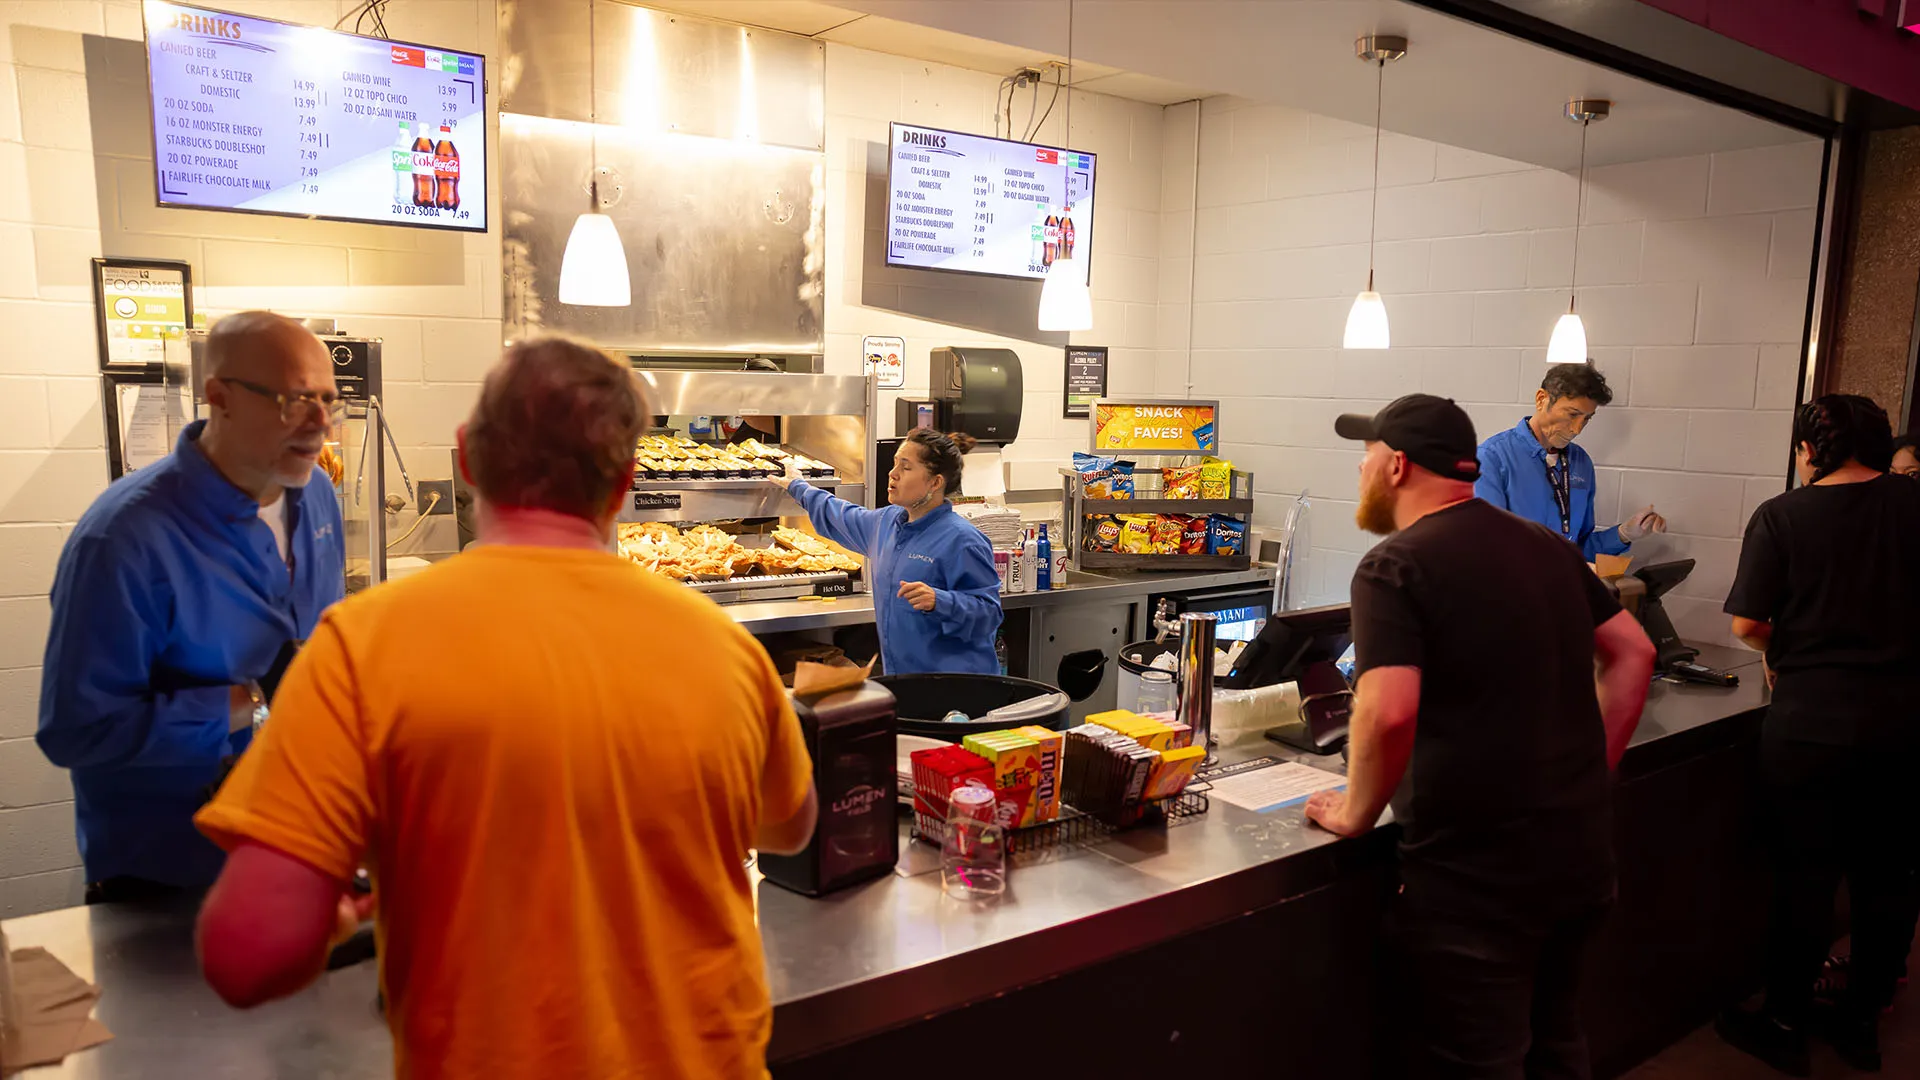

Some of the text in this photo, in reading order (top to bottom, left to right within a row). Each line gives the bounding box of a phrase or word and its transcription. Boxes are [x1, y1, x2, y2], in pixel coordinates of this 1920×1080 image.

[160, 41, 216, 59] CANNED BEER
[186, 64, 253, 83] CRAFT & SELTZER
[343, 70, 391, 88] CANNED WINE
[200, 84, 240, 100] DOMESTIC
[293, 80, 315, 92] 14.99
[438, 85, 456, 96] 13.99
[343, 87, 408, 105] 12 OZ TOPO CHICO
[164, 97, 214, 114] 20 OZ SODA
[294, 97, 316, 108] 13.99
[442, 102, 457, 112] 5.99
[344, 103, 417, 121] 20 OZ DASANI WATER
[166, 116, 262, 137] 16 OZ MONSTER ENERGY
[300, 115, 316, 126] 7.49
[442, 118, 458, 128] 4.99
[300, 132, 316, 144] 7.49
[902, 130, 946, 148] DRINKS
[166, 134, 266, 155] STARBUCKS DOUBLESHOT
[168, 152, 239, 170] 20 OZ POWERADE
[301, 150, 318, 160] 7.49
[898, 152, 930, 163] CANNED BEER
[302, 166, 318, 177] 7.49
[910, 166, 950, 178] CRAFT & SELTZER
[1004, 168, 1034, 179] CANNED WINE
[168, 170, 272, 190] FAIRLIFE CHOCOLATE MILK
[918, 180, 942, 190] DOMESTIC
[974, 175, 988, 184] 14.99
[1004, 179, 1044, 192] 12 OZ TOPO CHICO
[302, 184, 318, 194] 7.49
[896, 190, 926, 200] 20 OZ SODA
[973, 188, 987, 196] 13.99
[1004, 190, 1010, 198] 20
[1018, 192, 1034, 202] DASANI
[1035, 195, 1050, 204] WATER
[896, 202, 954, 216] 16 OZ MONSTER ENERGY
[976, 200, 986, 208] 7.49
[392, 204, 440, 217] 20 OZ SODA
[452, 209, 470, 220] 7.49
[974, 212, 986, 220] 7.49
[895, 216, 954, 229] STARBUCKS DOUBLESHOT
[974, 224, 985, 232] 7.49
[894, 228, 936, 240] 20 OZ POWERADE
[974, 236, 984, 245] 7.49
[894, 240, 954, 254] FAIRLIFE CHOCOLATE MILK
[105, 278, 151, 292] FOOD
[1082, 366, 1088, 376] 2
[1134, 406, 1182, 418] SNACK
[1134, 427, 1182, 438] FAVES!
[1082, 470, 1109, 482] RUFFLES
[635, 496, 662, 506] Chicken
[1216, 528, 1242, 538] Doritos
[908, 552, 935, 564] LUMEN
[1012, 560, 1020, 583] TRULY
[822, 584, 846, 594] Hot Dog
[1210, 608, 1245, 624] DASANI
[832, 786, 886, 813] LUMEN
[847, 804, 872, 816] FIELD
